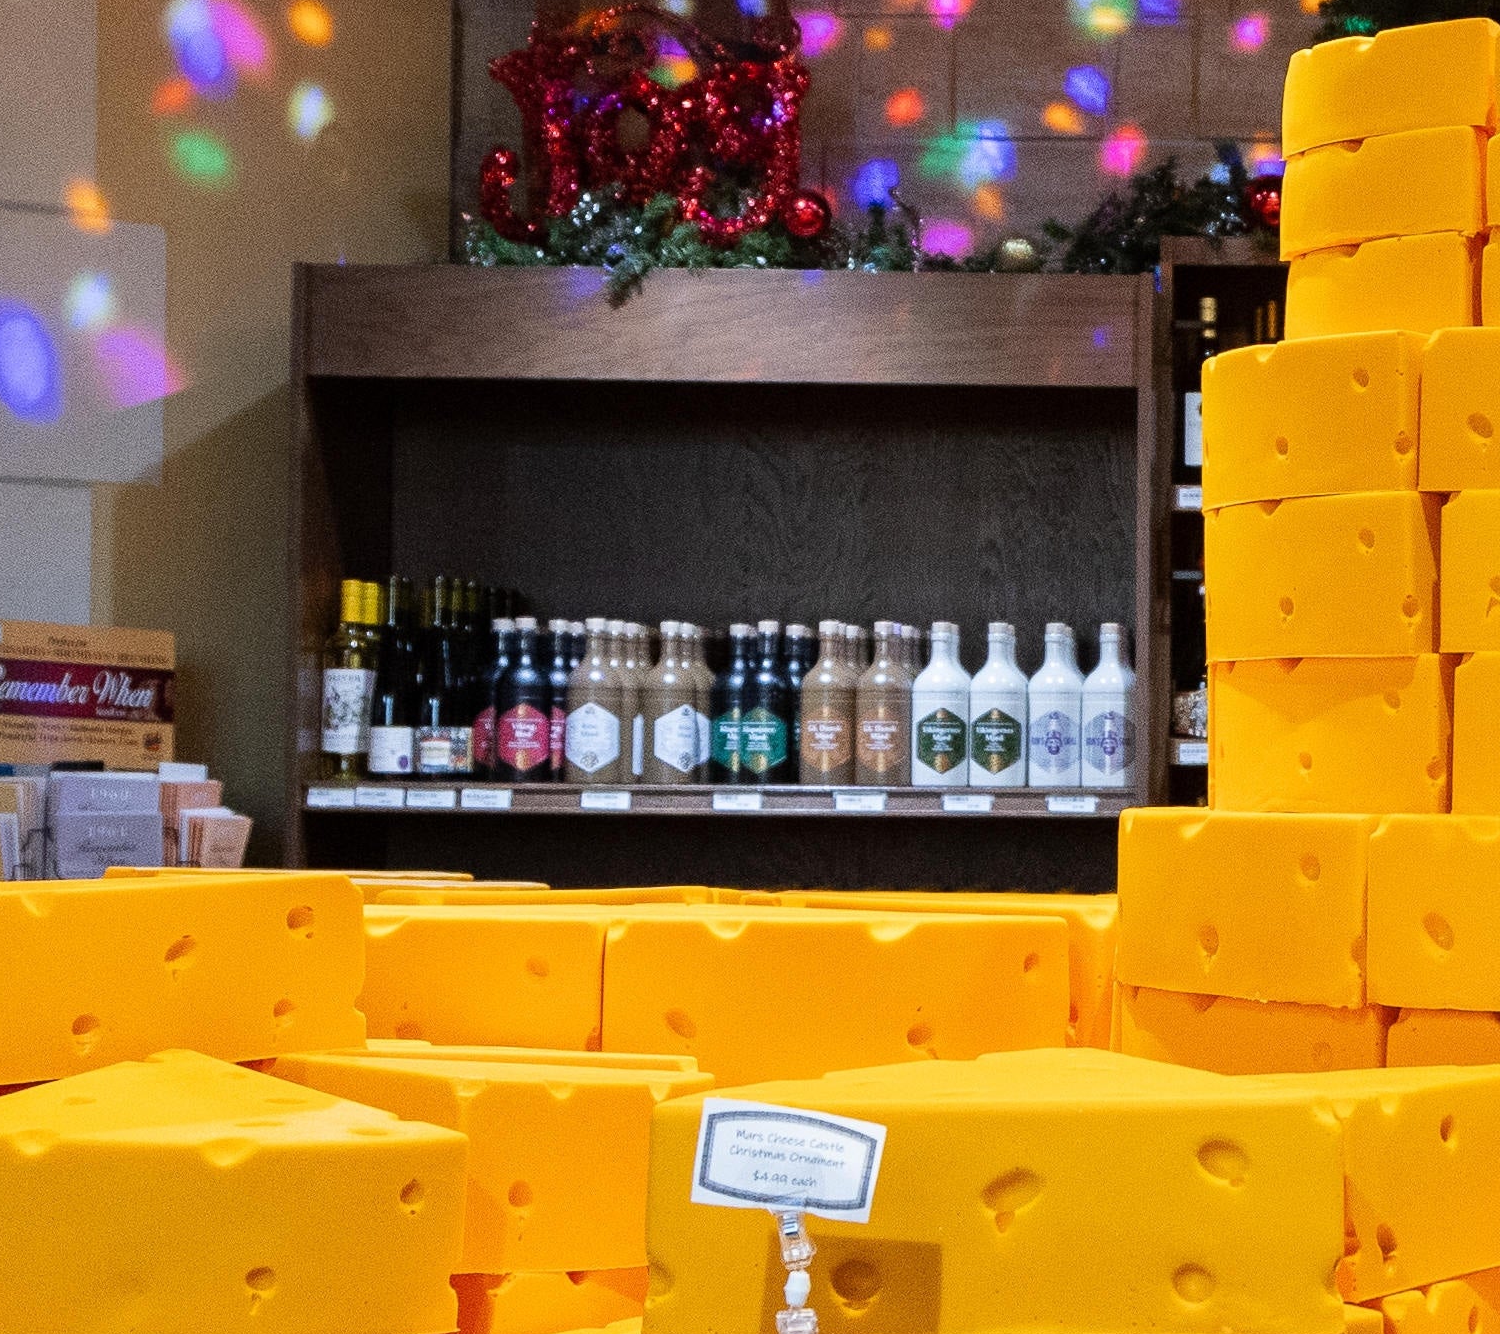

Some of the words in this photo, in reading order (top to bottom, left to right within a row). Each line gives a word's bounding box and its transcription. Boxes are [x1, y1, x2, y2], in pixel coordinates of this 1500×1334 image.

[92, 670, 155, 709] When
[735, 1128, 764, 1144] Mars
[767, 1132, 806, 1148] Cheese
[810, 1137, 845, 1154] Castle
[729, 1143, 787, 1162] Christmas
[789, 1151, 846, 1169] Ornament
[752, 1169, 788, 1185] $4.99
[791, 1174, 818, 1188] each
